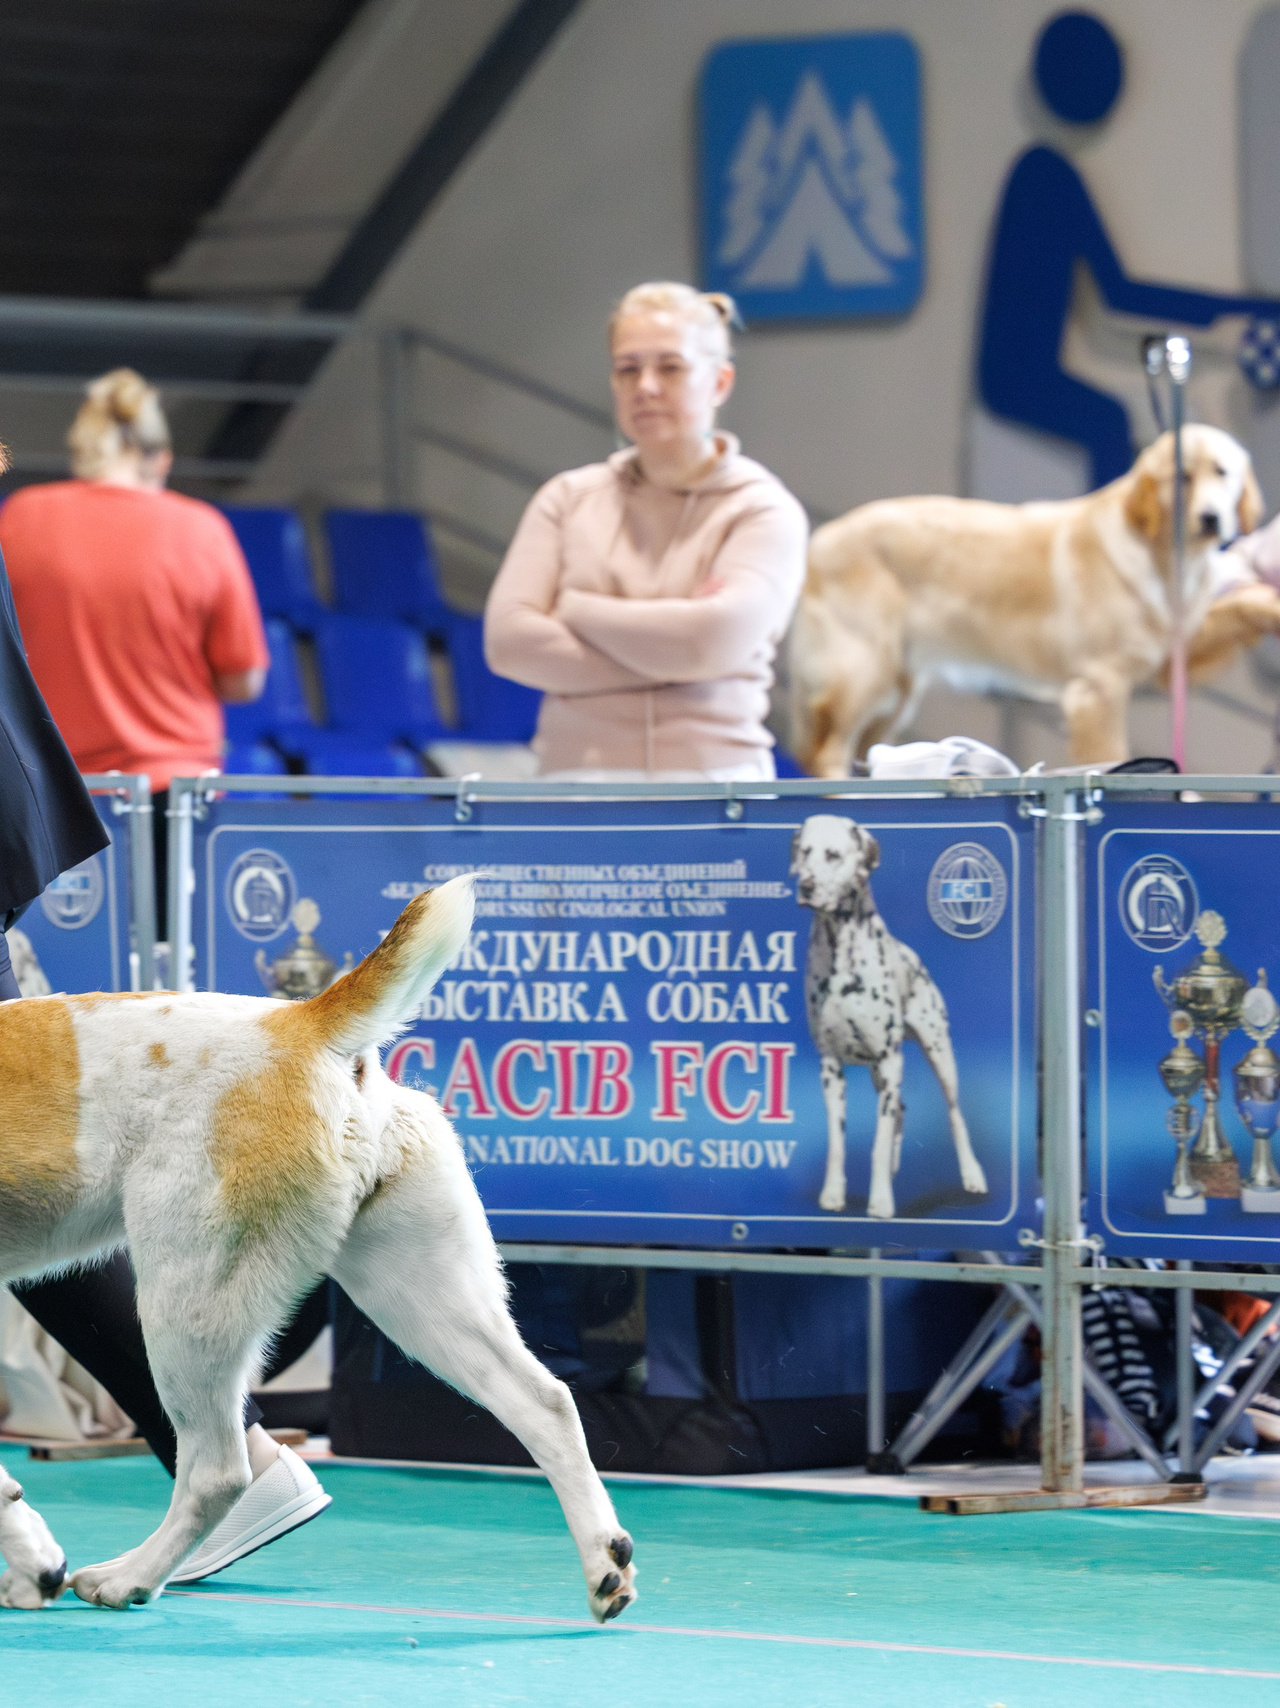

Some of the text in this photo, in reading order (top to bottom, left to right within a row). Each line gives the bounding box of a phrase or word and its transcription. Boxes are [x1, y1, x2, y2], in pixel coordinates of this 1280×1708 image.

[671, 900, 727, 917] UNION
[420, 981, 790, 1024] ЫСТАВКА СОБАК
[385, 1036, 797, 1123] CACIB FCI
[463, 1134, 798, 1169] NATIONAL DOG SHOW
